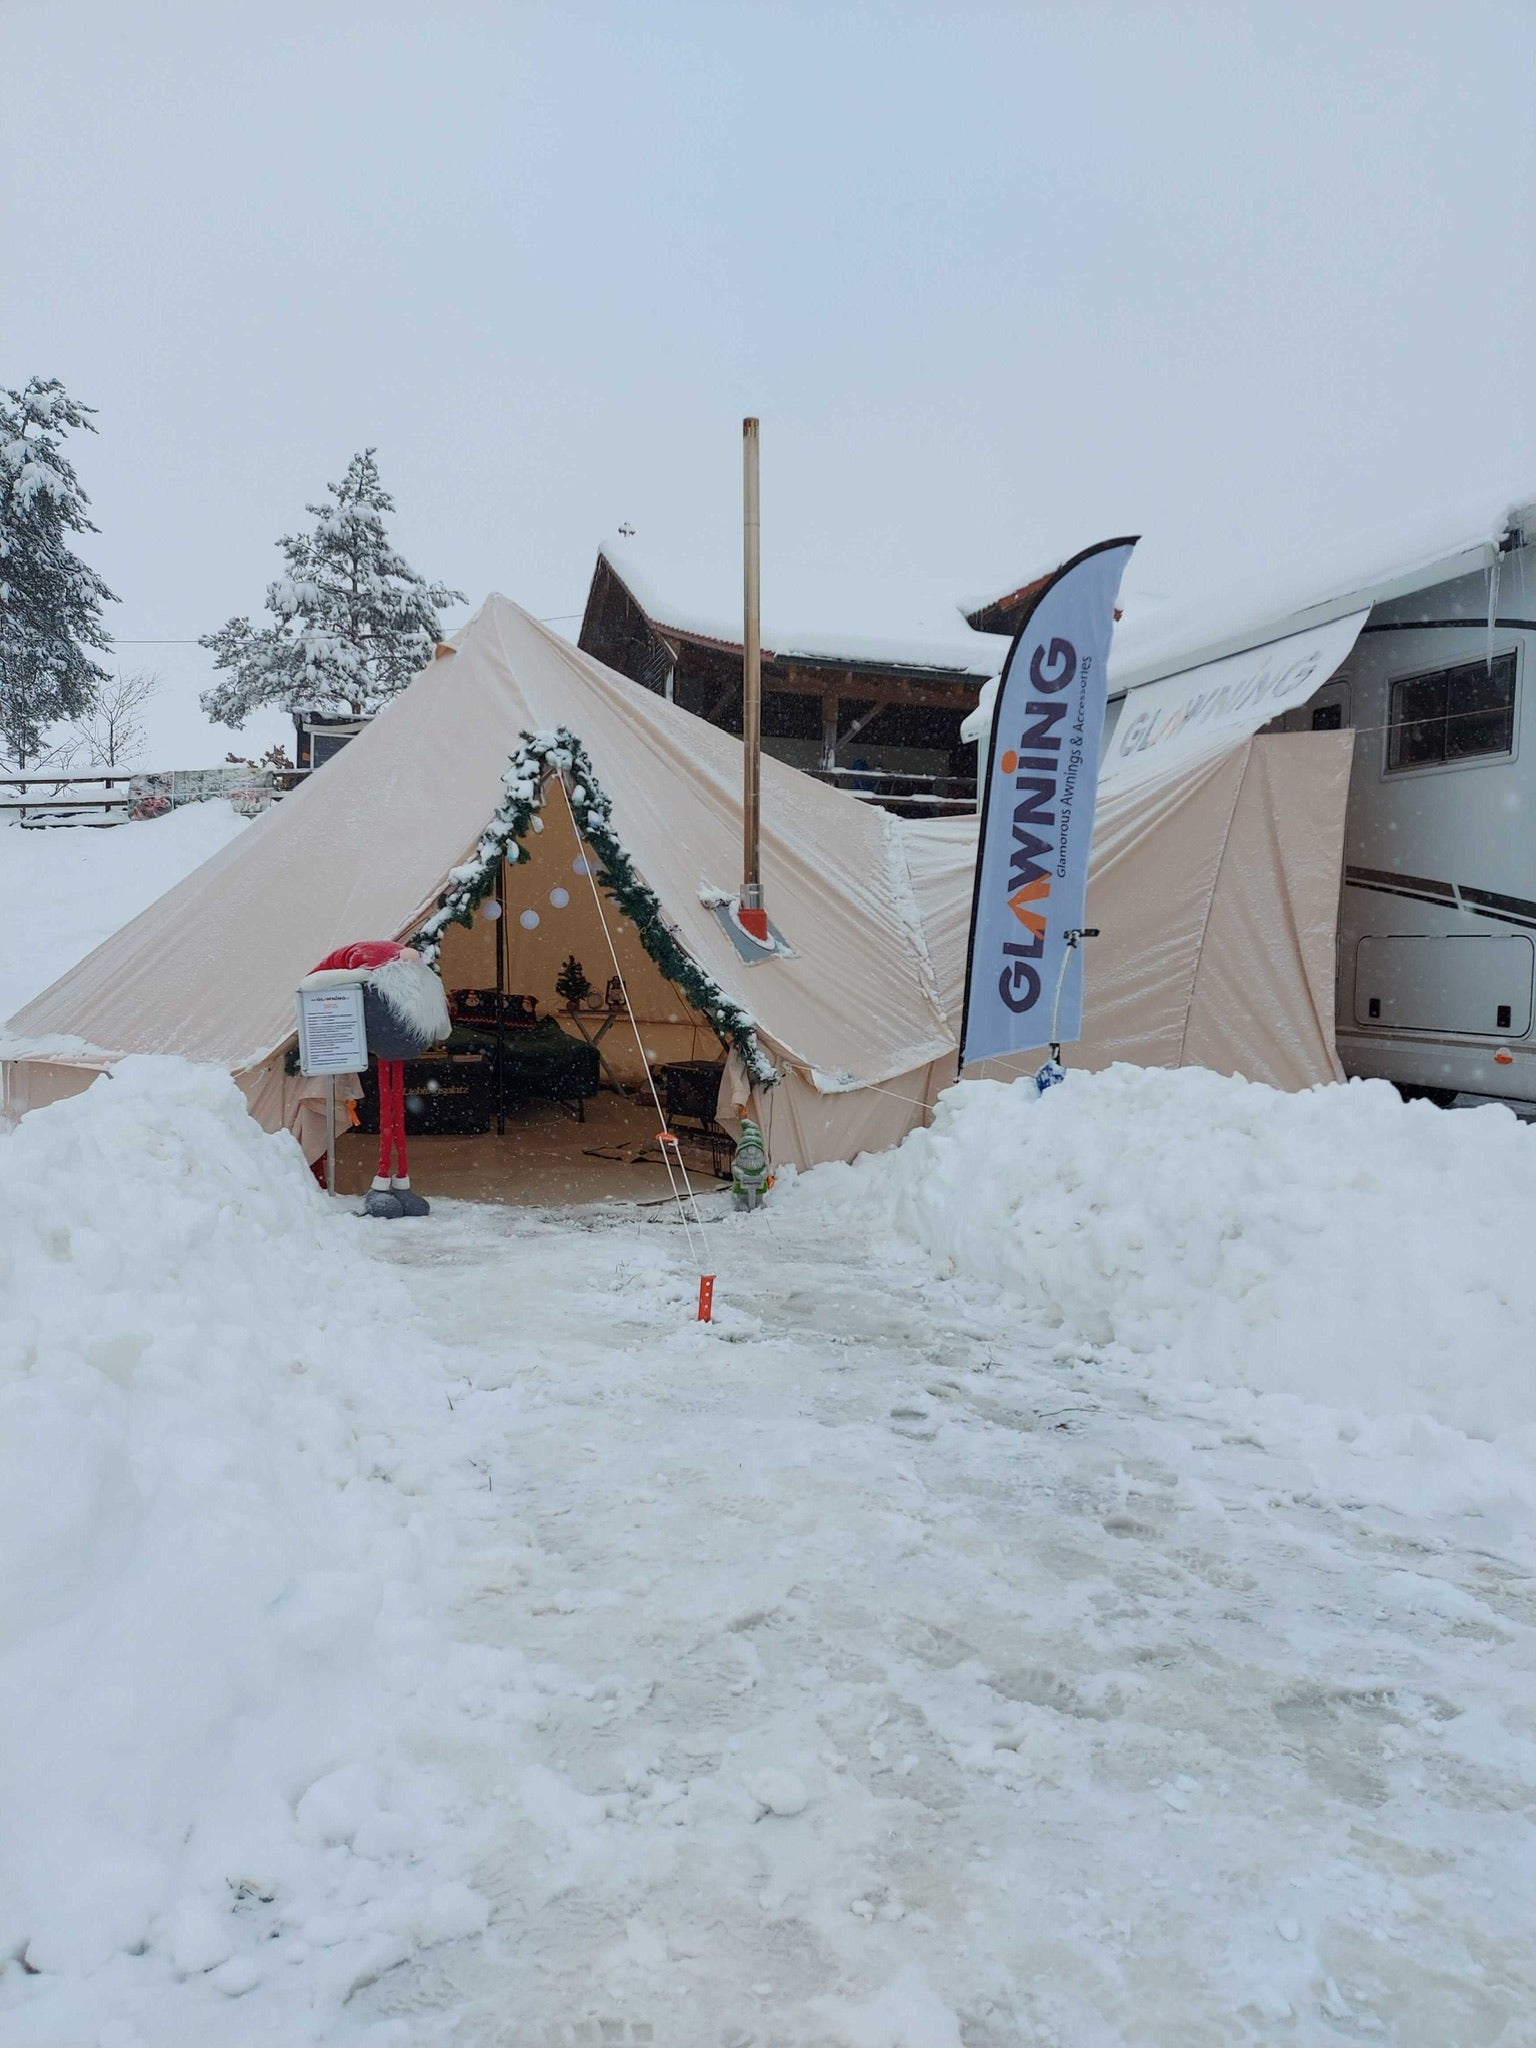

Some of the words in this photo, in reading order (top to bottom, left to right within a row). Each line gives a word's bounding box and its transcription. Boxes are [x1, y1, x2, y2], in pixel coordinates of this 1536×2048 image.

[1073, 655, 1092, 732] Accessories
[1070, 735, 1083, 747] &
[1060, 750, 1083, 807] Awnings
[999, 637, 1077, 1014] GLAWNING
[1056, 807, 1072, 879] Glamorous
